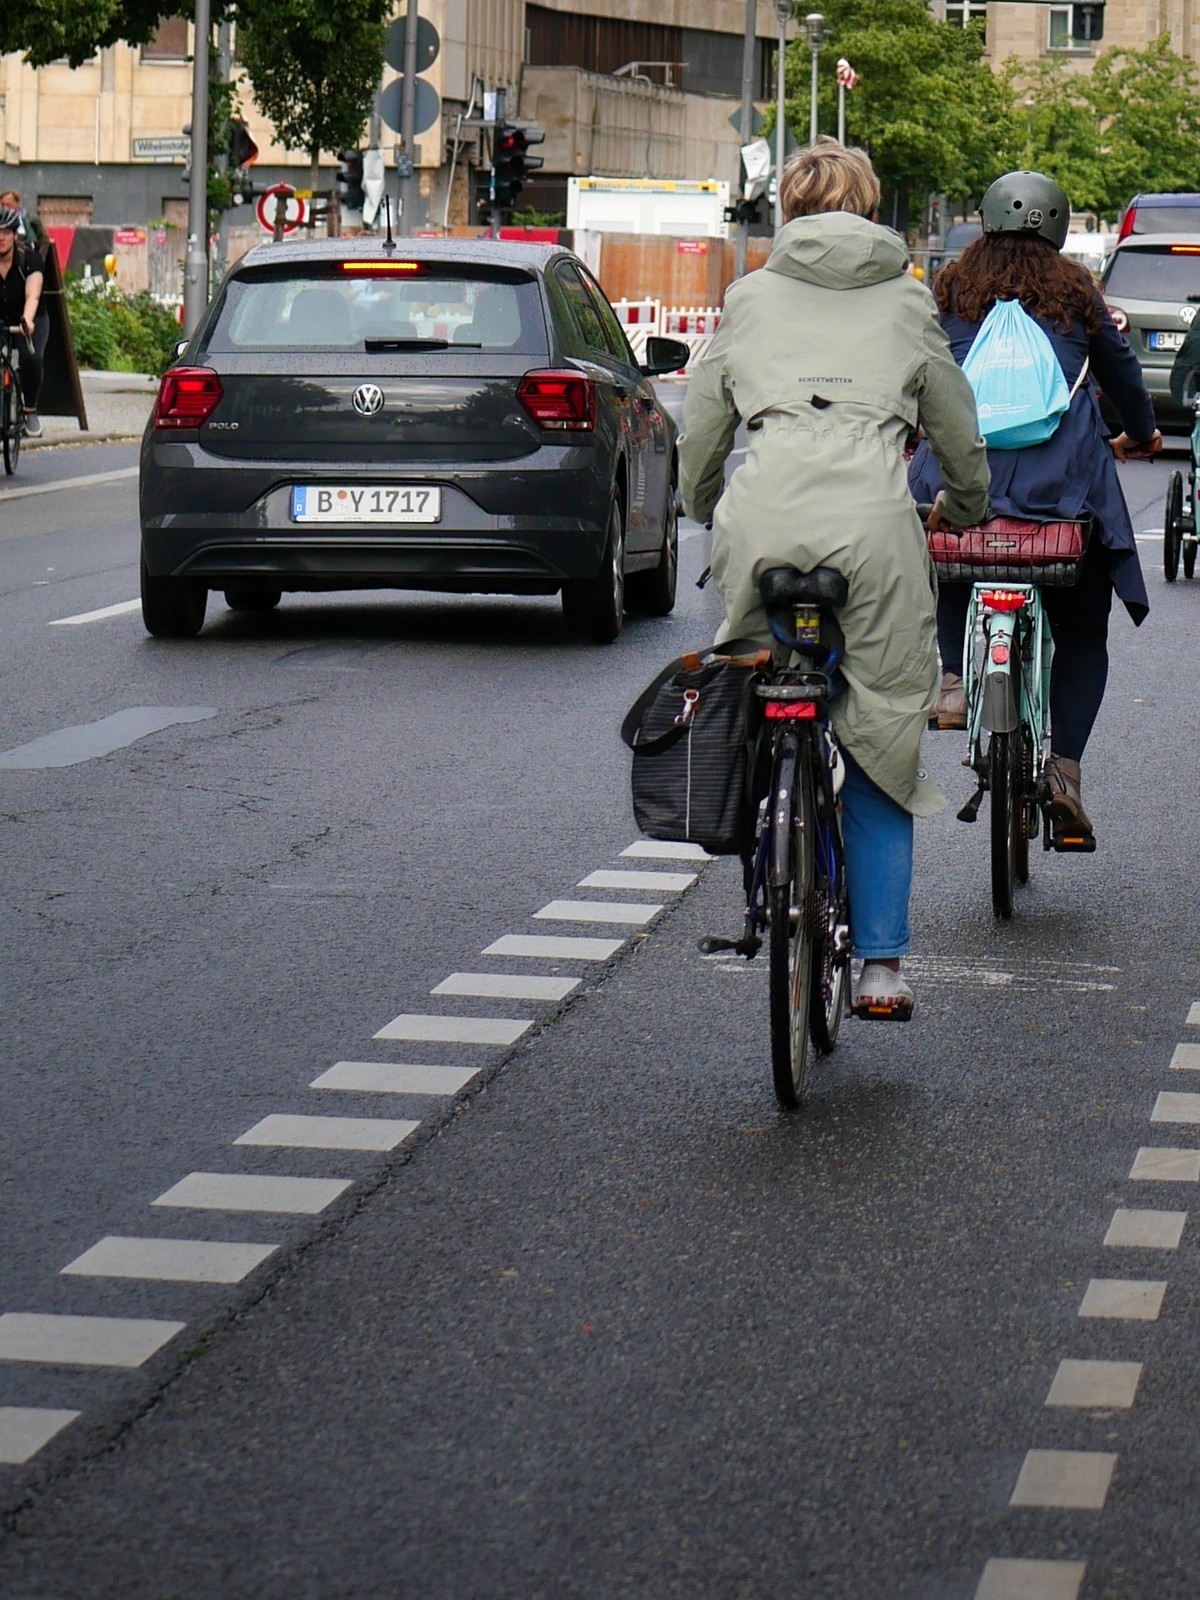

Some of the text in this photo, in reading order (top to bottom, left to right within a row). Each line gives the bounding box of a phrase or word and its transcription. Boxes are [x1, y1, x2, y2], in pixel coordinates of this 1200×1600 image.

[798, 376, 853, 384] SCHIETWETTER
[209, 422, 239, 430] POLO
[317, 490, 431, 513] B Y 1717
